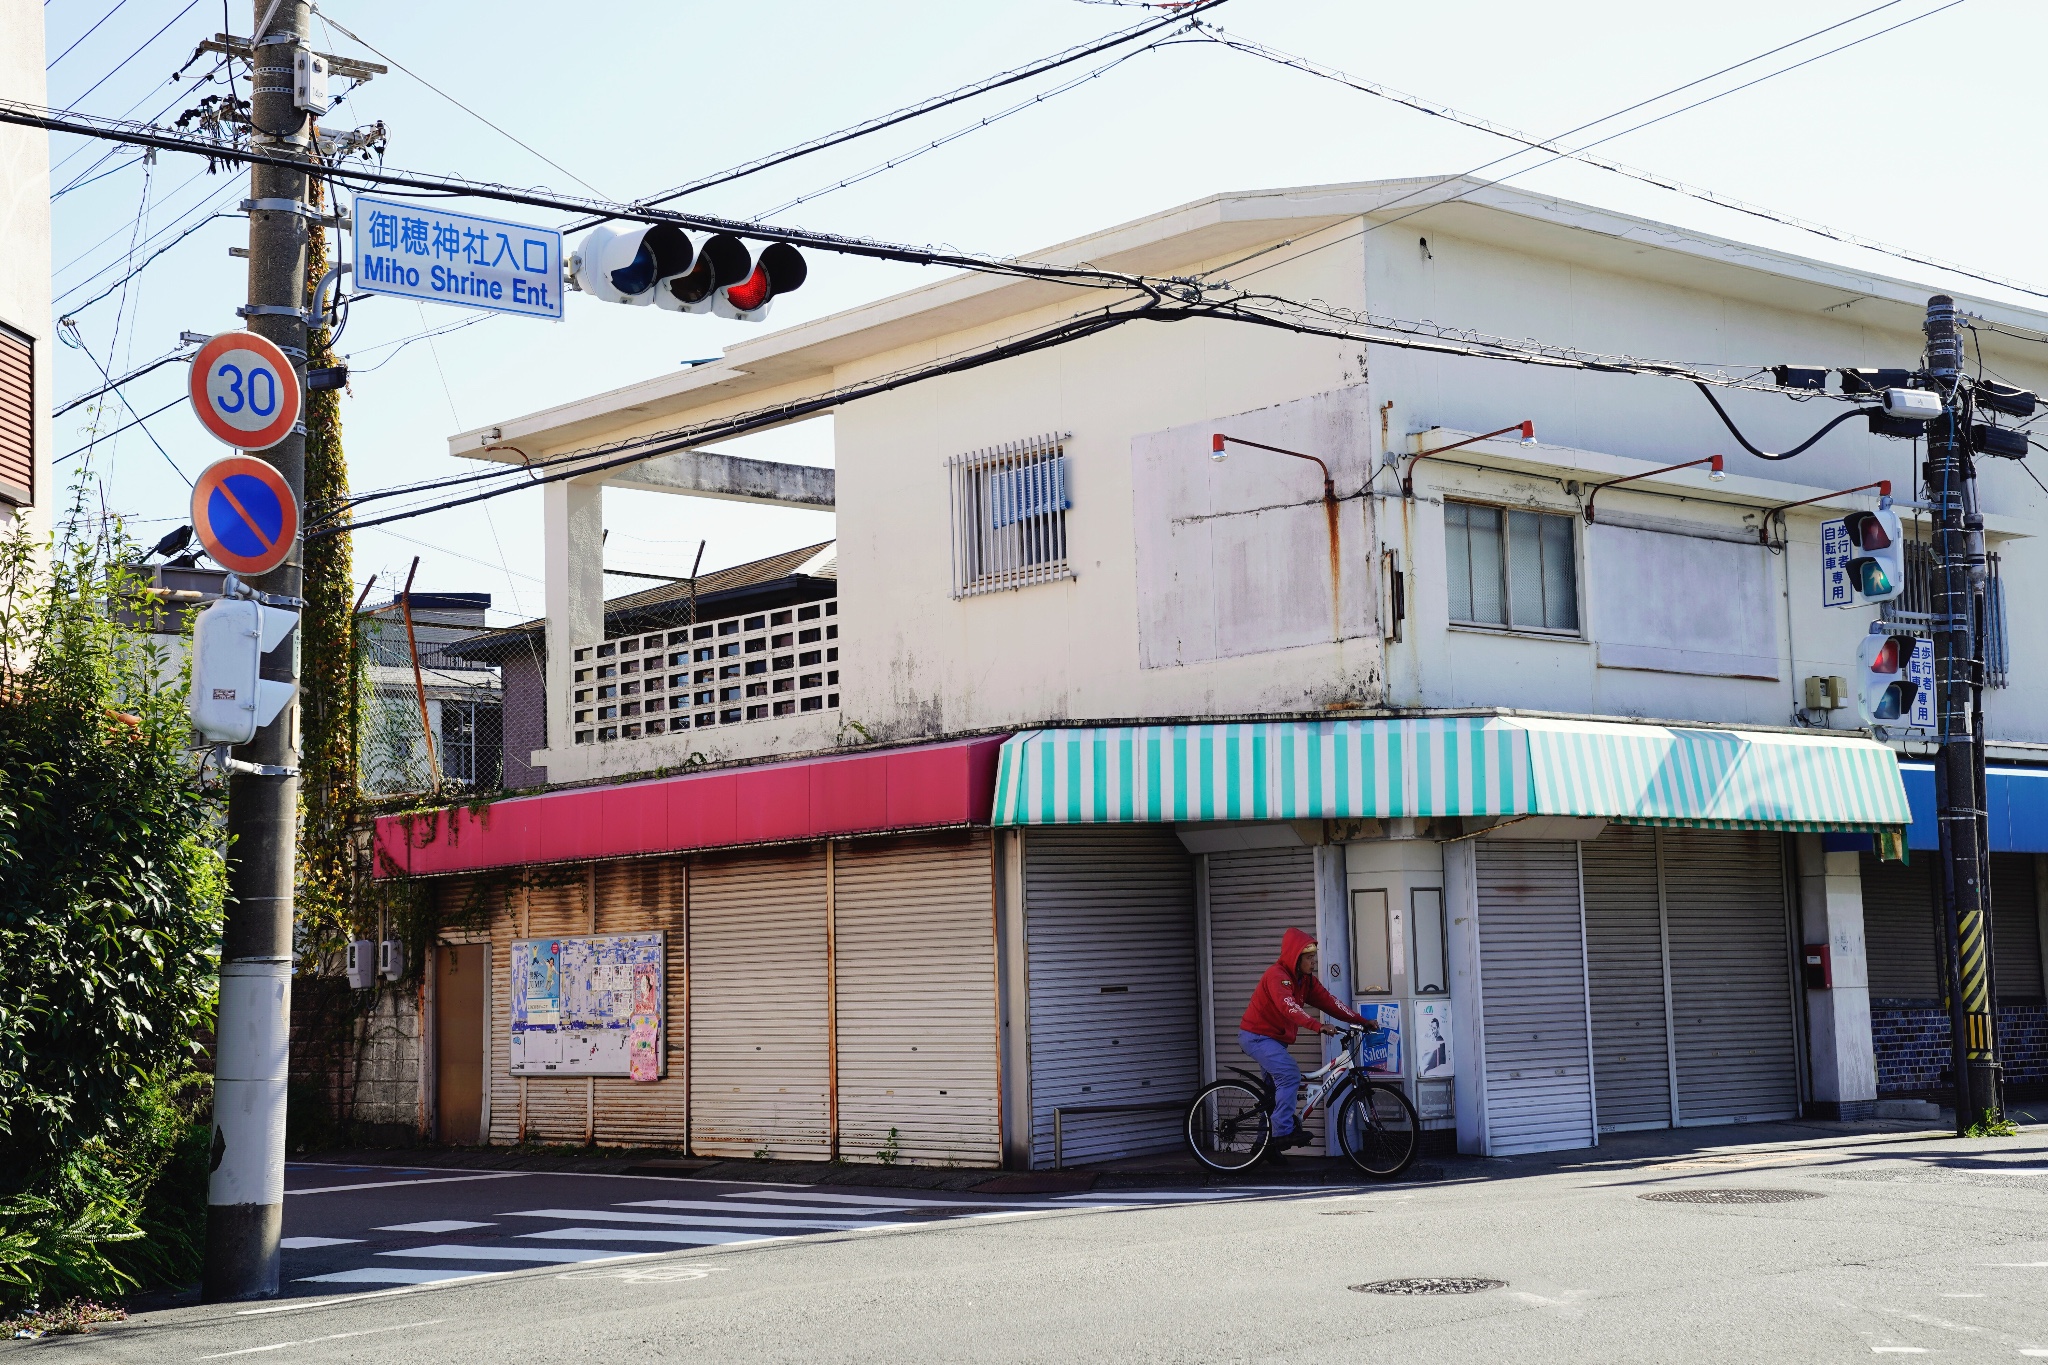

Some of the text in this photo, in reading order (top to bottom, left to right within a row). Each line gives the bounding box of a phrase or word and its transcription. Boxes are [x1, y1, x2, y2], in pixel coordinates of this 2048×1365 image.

[368, 210, 548, 275] 御穂神社入口
[364, 254, 554, 310] Miho Shrine Ent.
[217, 363, 276, 417] 30
[1363, 1047, 1388, 1063] Salem
